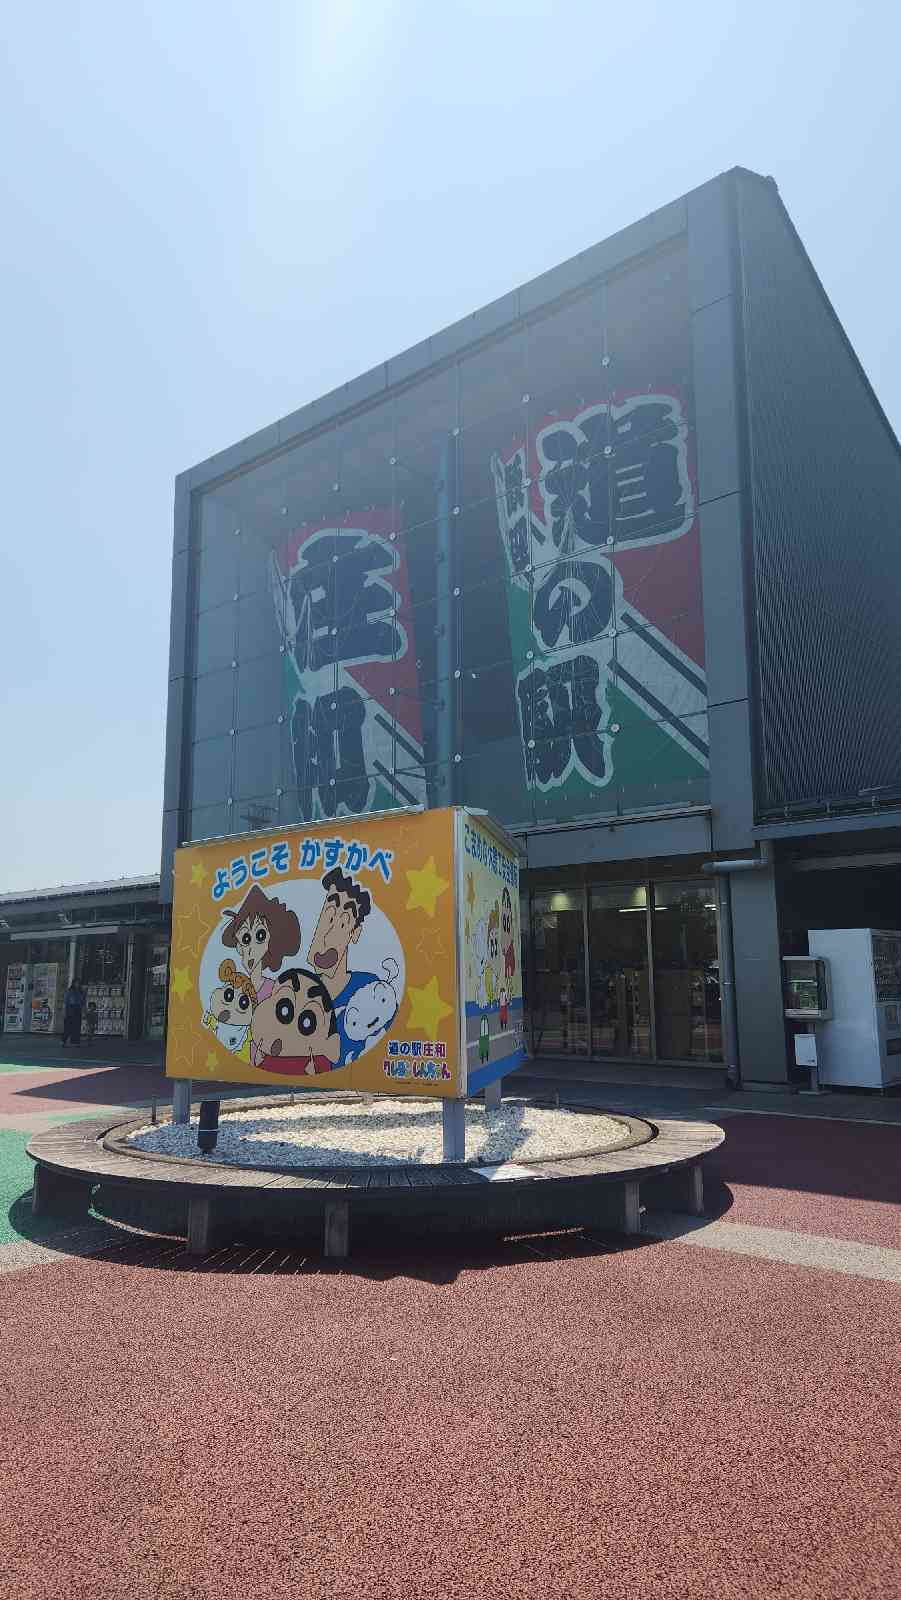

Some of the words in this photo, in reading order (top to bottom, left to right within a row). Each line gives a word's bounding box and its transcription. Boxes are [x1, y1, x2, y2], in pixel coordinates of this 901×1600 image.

[517, 396, 692, 788] 道の駅
[212, 841, 290, 899] ようこそ
[300, 837, 392, 884] かすかべ
[388, 1040, 447, 1058] 道の駅庄和
